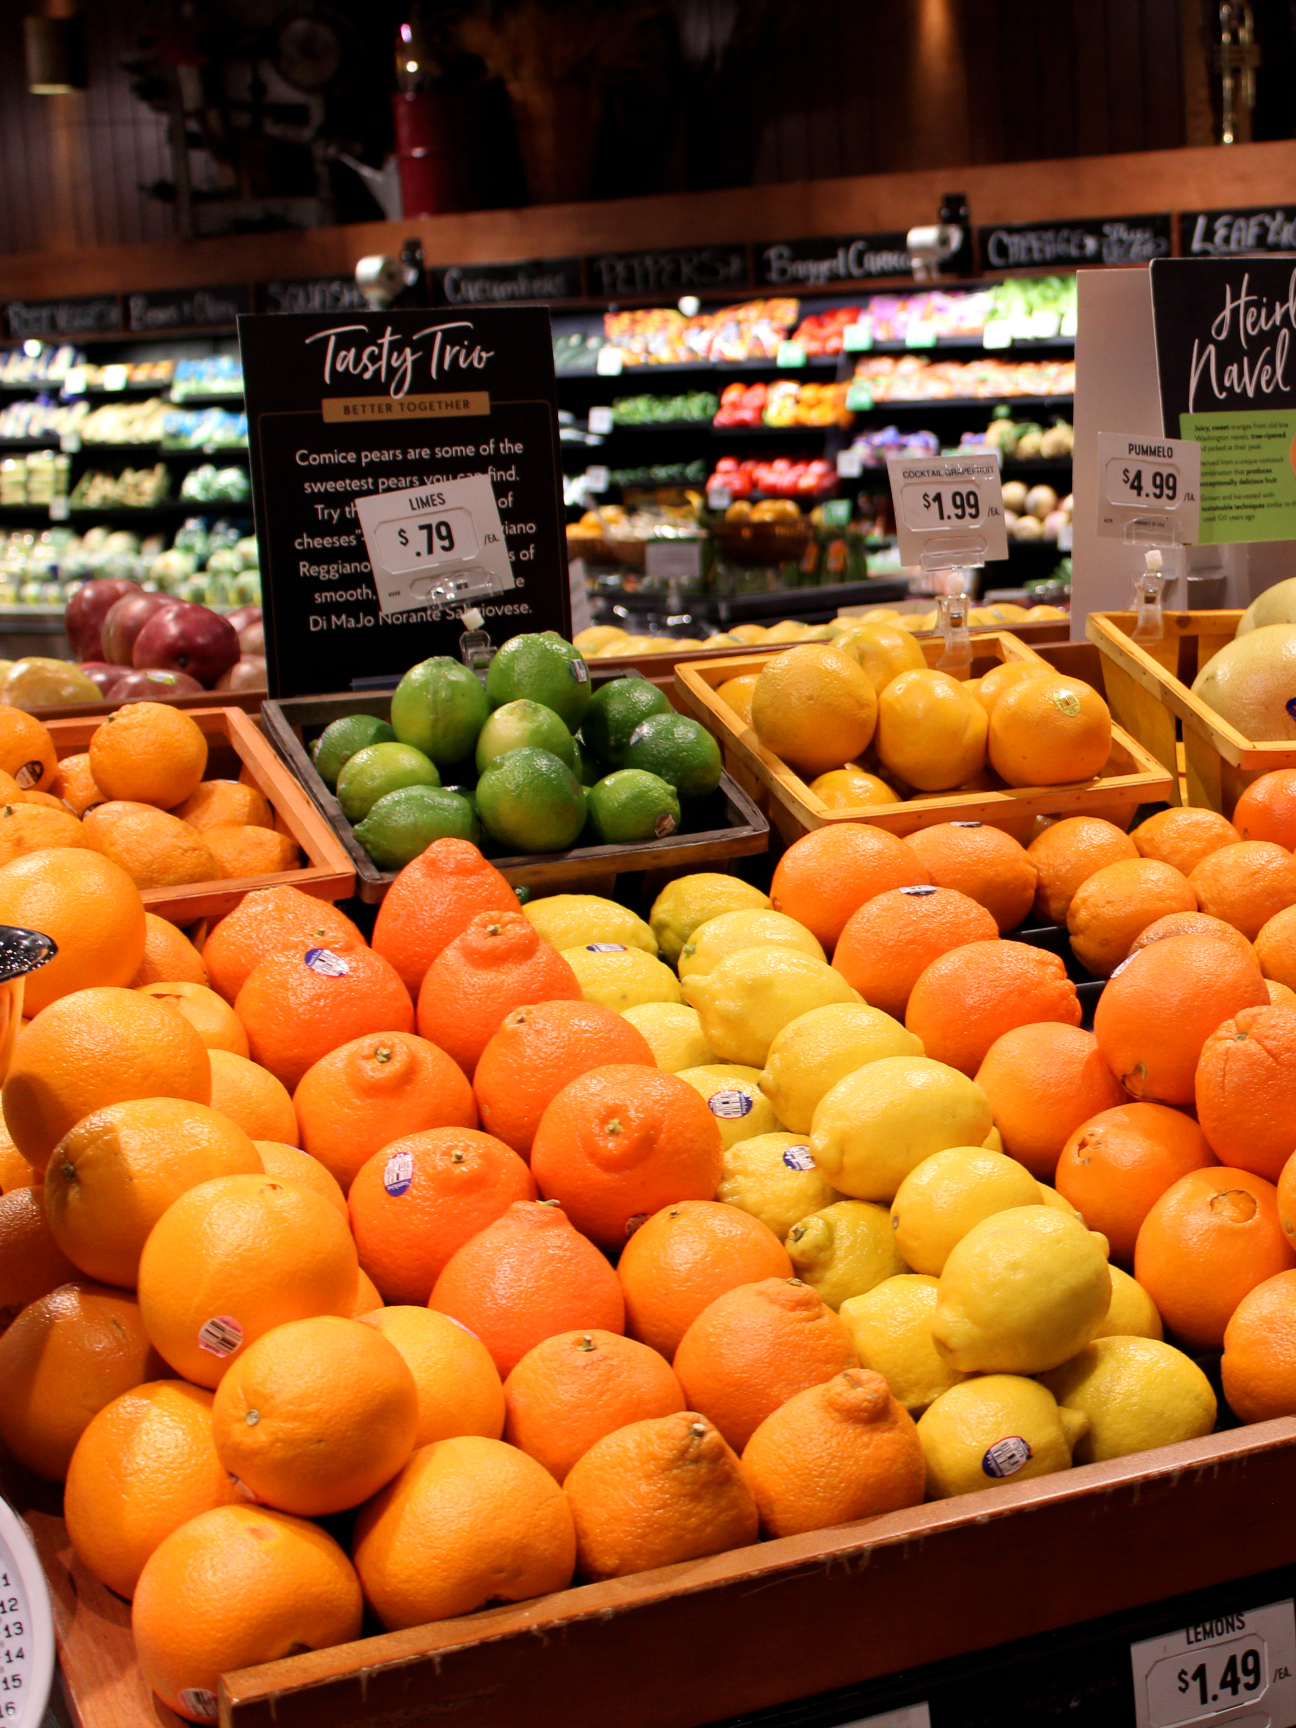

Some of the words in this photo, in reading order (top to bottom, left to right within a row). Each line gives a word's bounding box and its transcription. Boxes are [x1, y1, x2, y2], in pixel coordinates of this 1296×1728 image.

[305, 324, 423, 400] Tasty
[412, 321, 495, 381] Trio
[1188, 327, 1291, 415] Navel
[343, 403, 393, 416] BETTER
[399, 399, 470, 413] TOGETHER
[295, 449, 357, 466] Comice
[361, 448, 403, 467] pears
[407, 448, 431, 461] are
[435, 445, 475, 459] some
[479, 440, 496, 455] of
[499, 438, 524, 454] the
[1128, 443, 1174, 459] PUMMELO
[303, 475, 374, 494] sweetest
[378, 474, 420, 493] pears
[487, 465, 520, 483] find.
[902, 469, 943, 479] COCKTAIL
[1122, 467, 1178, 501] $4.99
[314, 504, 341, 525] Try
[498, 492, 514, 509] of
[408, 492, 446, 511] LIMES
[922, 490, 980, 521] $1.99
[987, 506, 1000, 518] /EA.
[483, 533, 500, 546] /EA.
[299, 560, 371, 580] Reggiano
[519, 543, 536, 561] of
[314, 587, 377, 604] smooth,
[309, 614, 328, 631] Di
[331, 612, 375, 629] MaJo
[379, 606, 442, 626] Norante
[4, 1621, 24, 1638] 13
[1185, 1611, 1246, 1647] LEMONS
[5, 1647, 25, 1663] 14
[2, 1674, 22, 1691] 15
[1176, 1647, 1262, 1707] $1.49
[1272, 1666, 1293, 1685] /EA.
